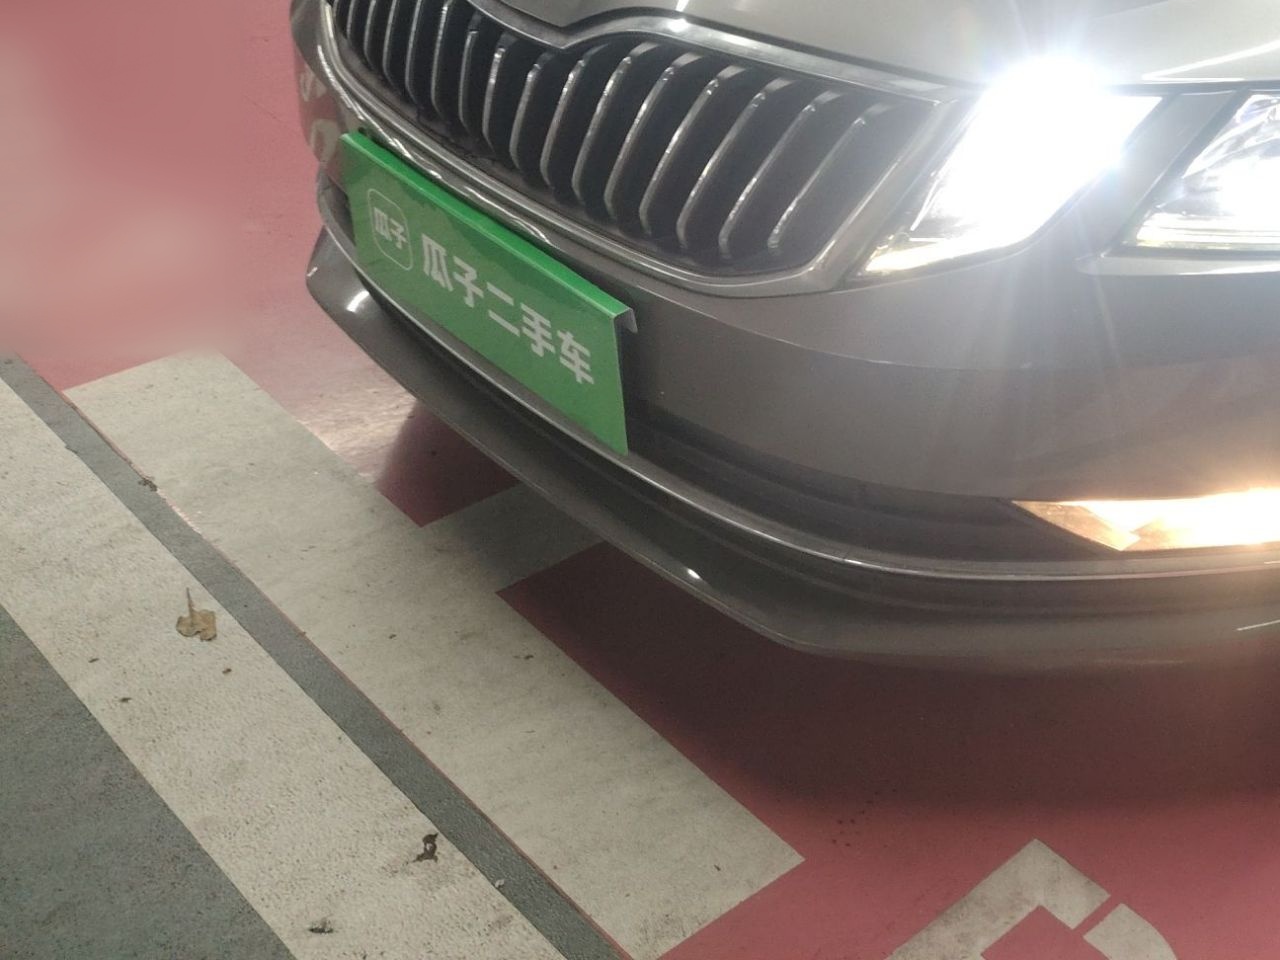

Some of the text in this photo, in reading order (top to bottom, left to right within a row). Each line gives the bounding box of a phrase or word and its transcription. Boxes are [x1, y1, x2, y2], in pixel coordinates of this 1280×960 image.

[373, 206, 408, 250] 瓜子
[421, 233, 595, 385] 瓜子二手车
